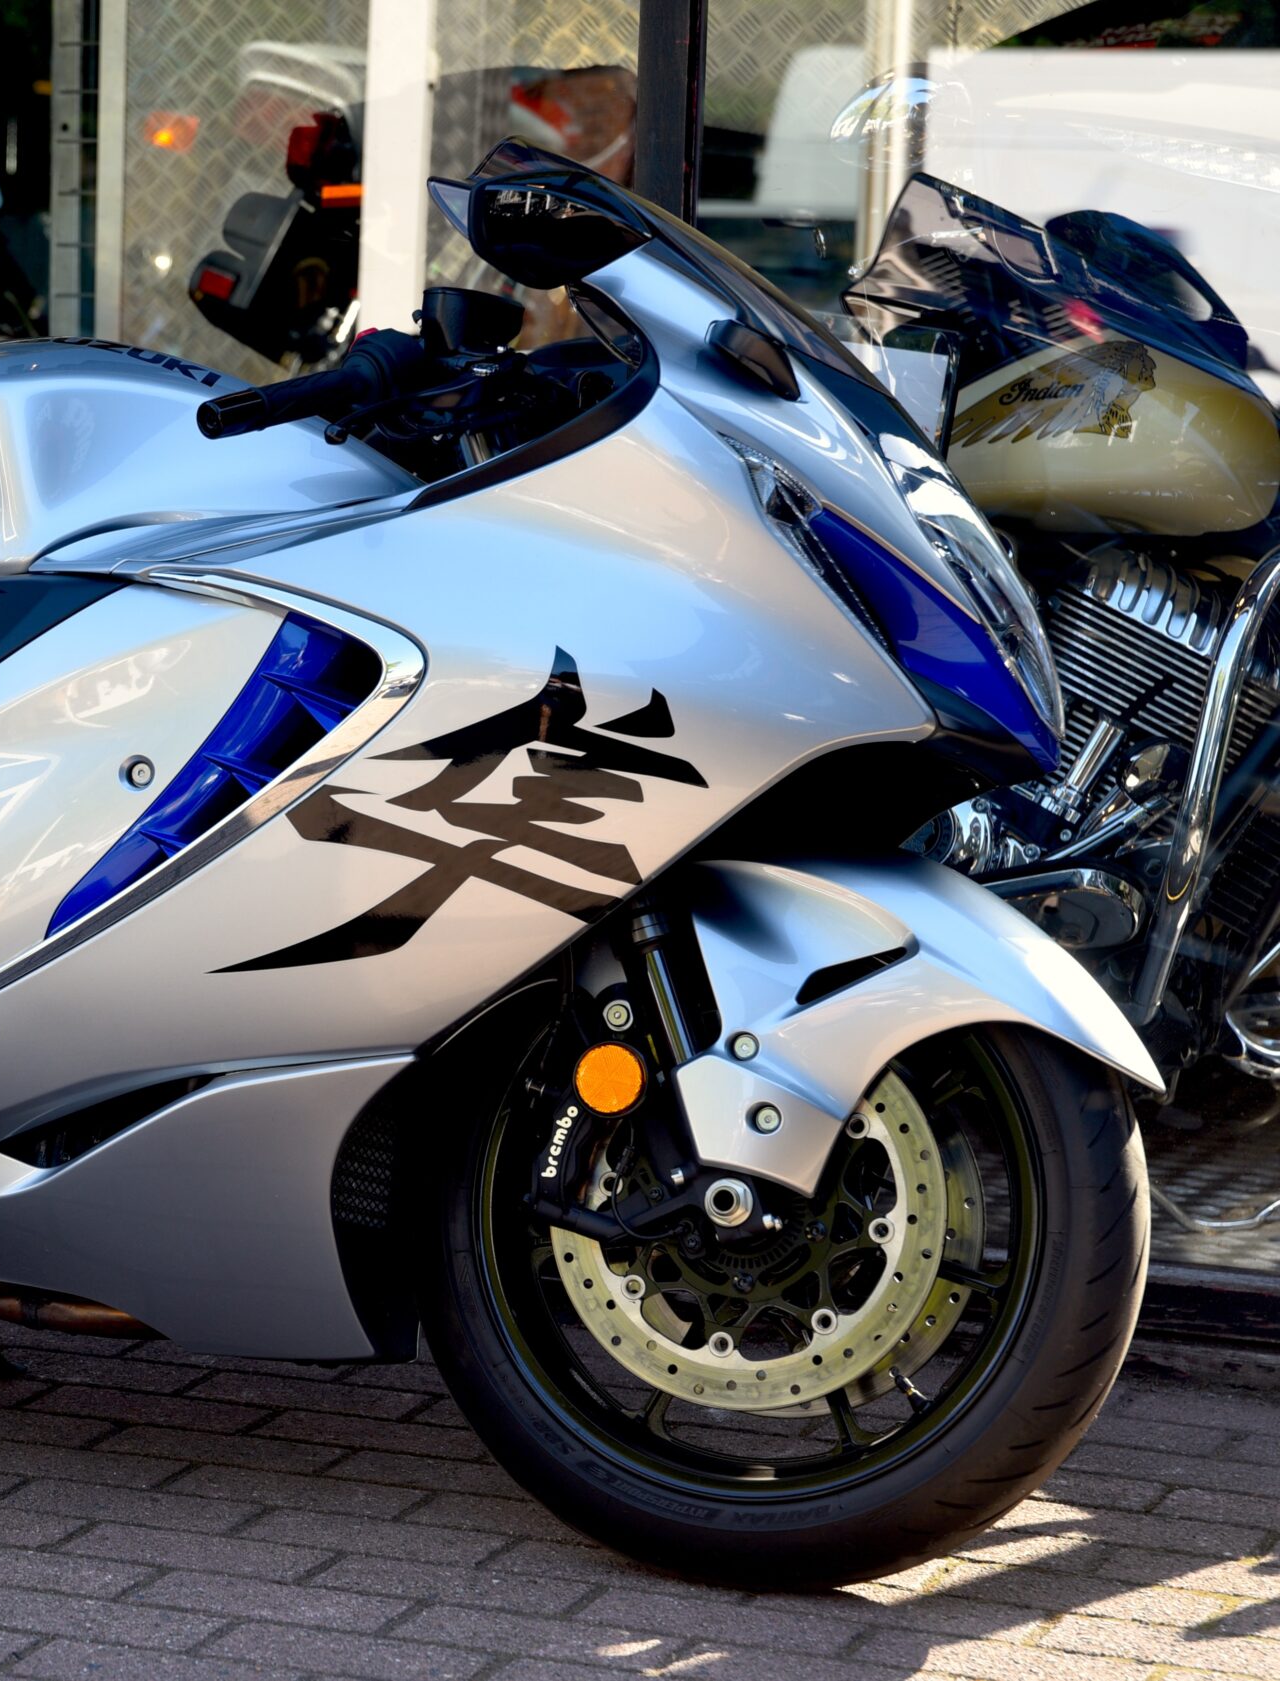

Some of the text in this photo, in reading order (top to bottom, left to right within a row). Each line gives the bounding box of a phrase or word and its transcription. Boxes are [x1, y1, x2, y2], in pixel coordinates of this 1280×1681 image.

[16, 337, 222, 388] UZUKI
[999, 375, 1085, 406] Indian
[541, 1105, 579, 1178] brembo
